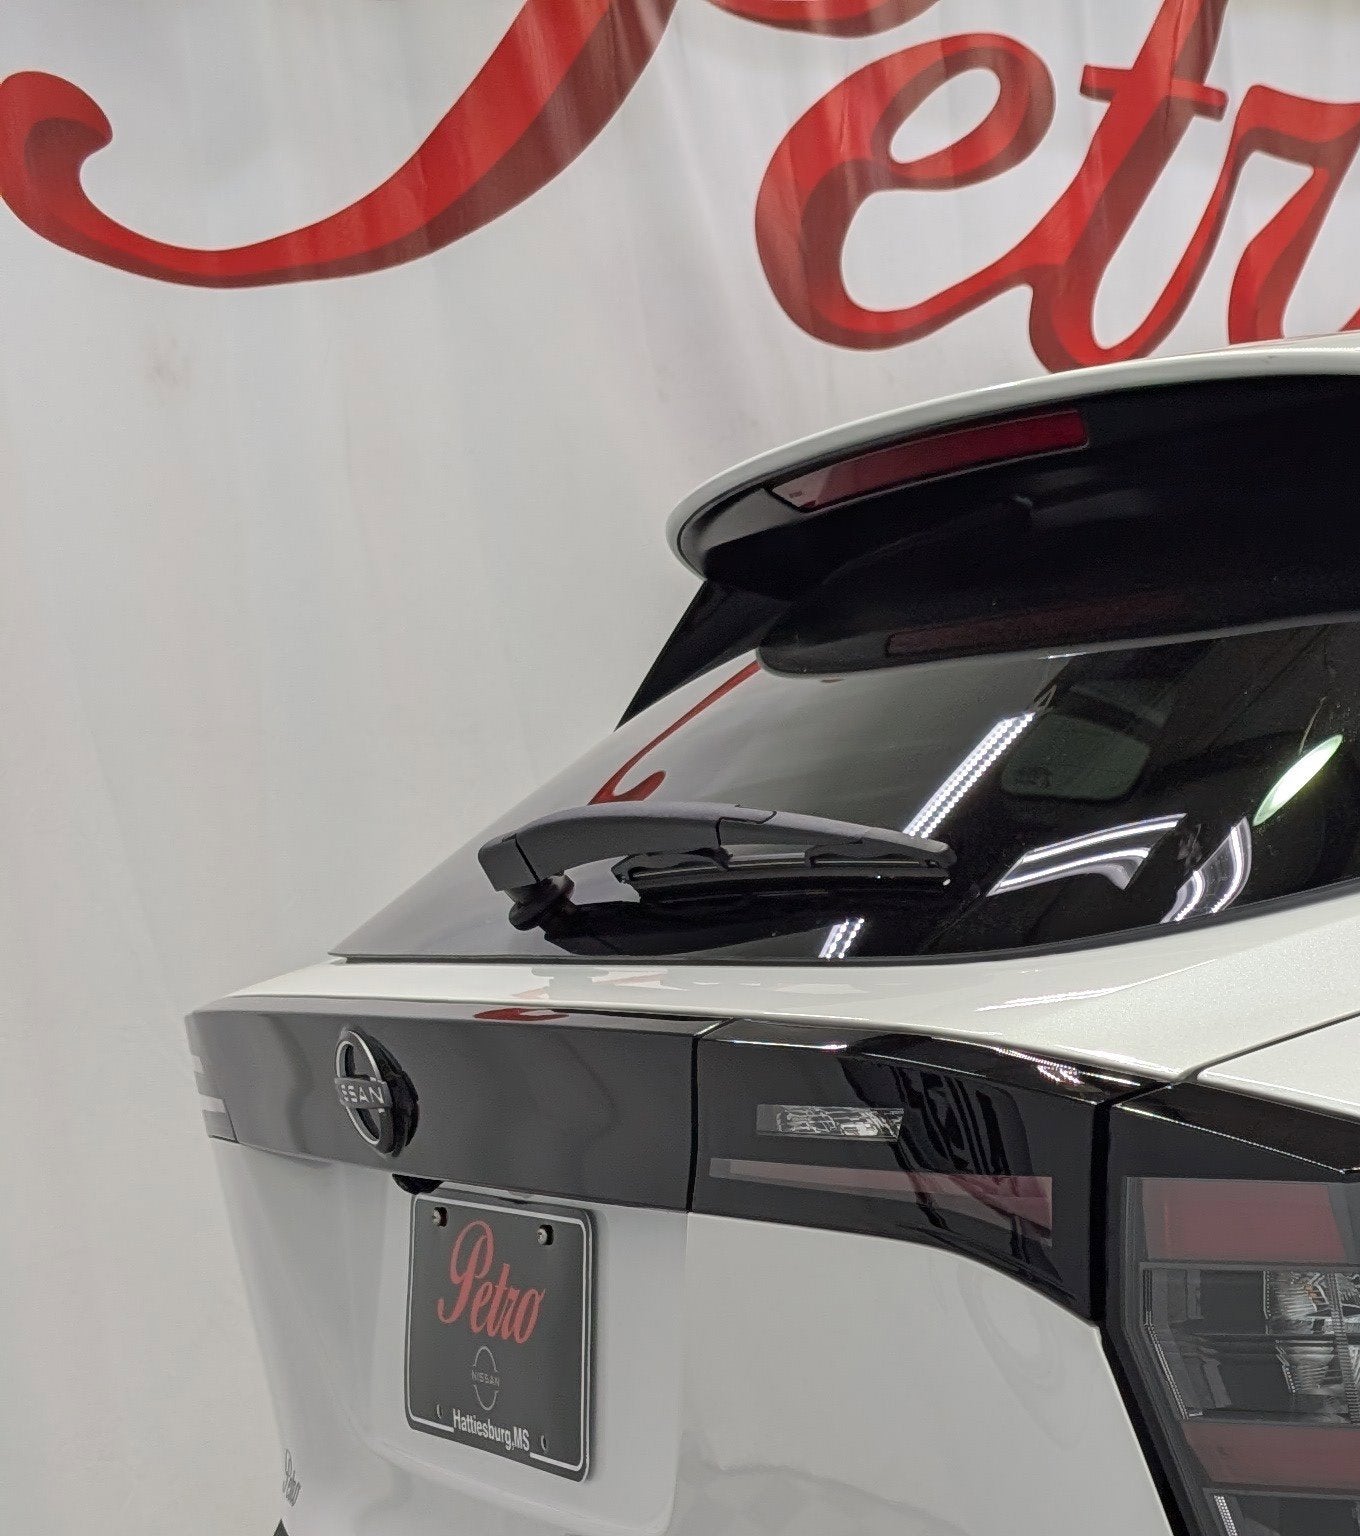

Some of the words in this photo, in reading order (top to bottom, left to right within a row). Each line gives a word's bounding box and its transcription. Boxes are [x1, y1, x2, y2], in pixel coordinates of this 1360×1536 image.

[340, 1083, 385, 1105] SSAN
[436, 1220, 546, 1344] Petro
[471, 1369, 500, 1388] NISSAN
